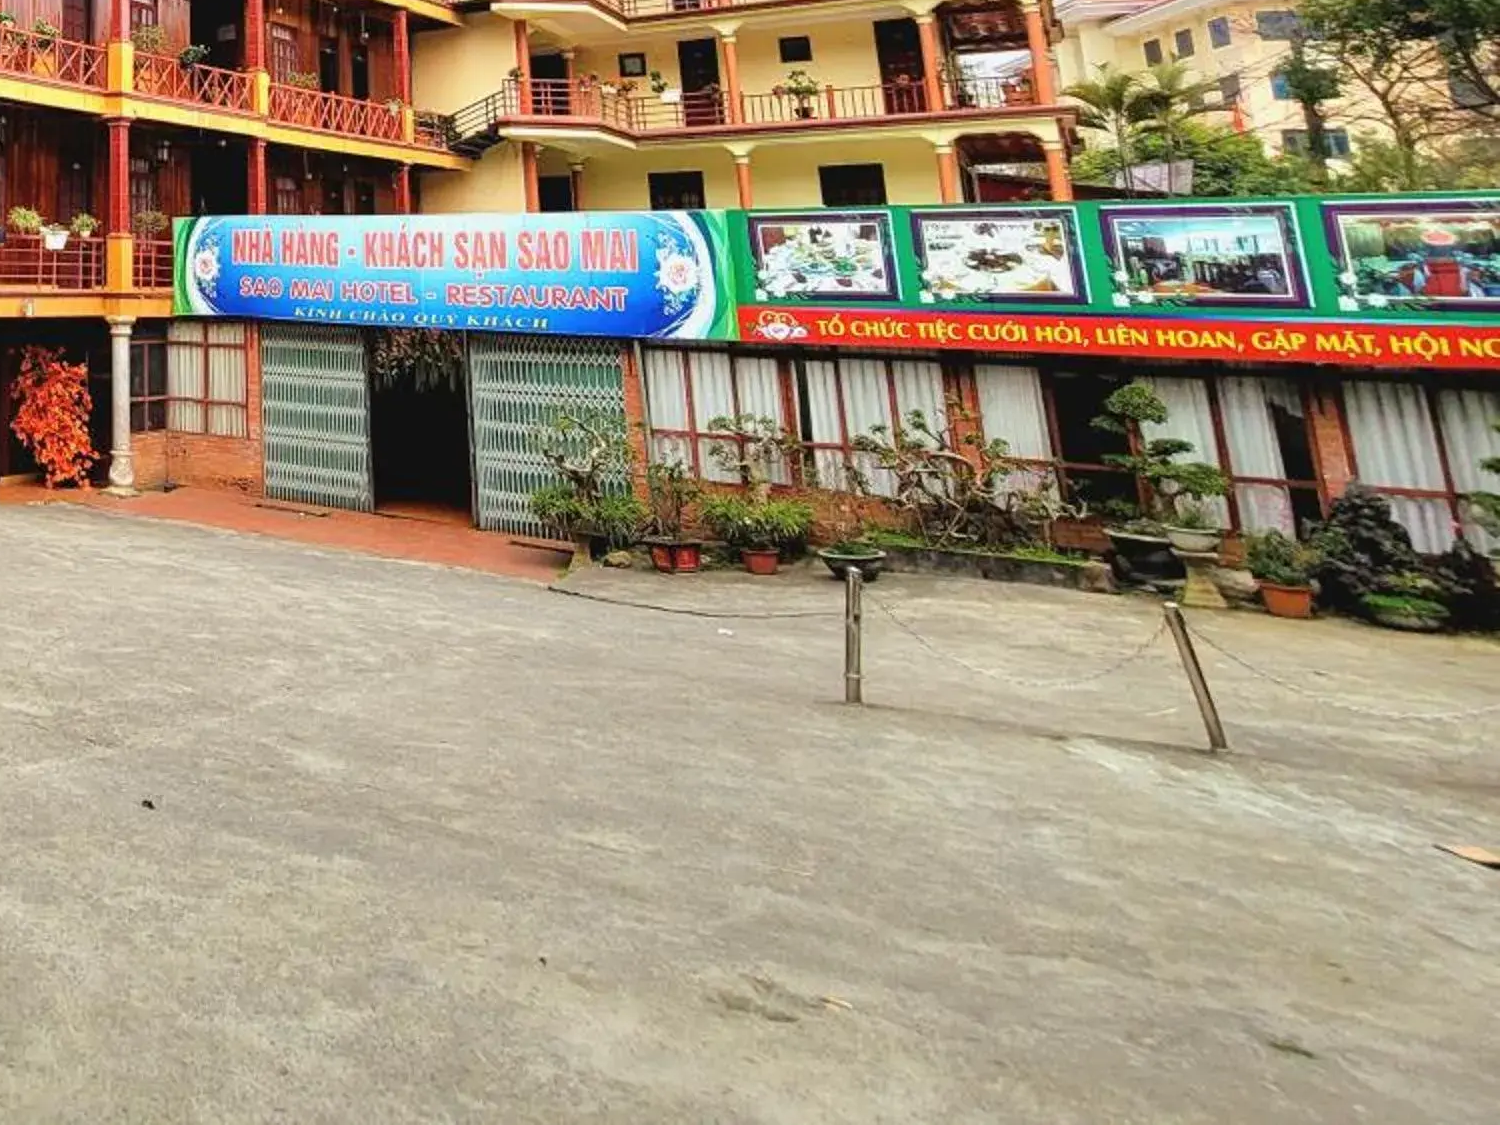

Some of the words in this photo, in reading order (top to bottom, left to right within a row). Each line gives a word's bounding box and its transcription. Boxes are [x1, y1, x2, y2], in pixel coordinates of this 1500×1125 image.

[364, 224, 445, 269] KHÁCH
[453, 230, 507, 279] SẠN
[516, 230, 570, 270] SAO
[580, 229, 638, 271] MAI
[240, 275, 283, 298] SAO
[290, 278, 335, 301] MAI
[341, 280, 418, 305] HOTEL
[446, 283, 628, 311] RESTAURANT
[1096, 323, 1149, 346] LIÊN
[1156, 330, 1244, 353] HOAN,
[1389, 331, 1451, 361] HỘI
